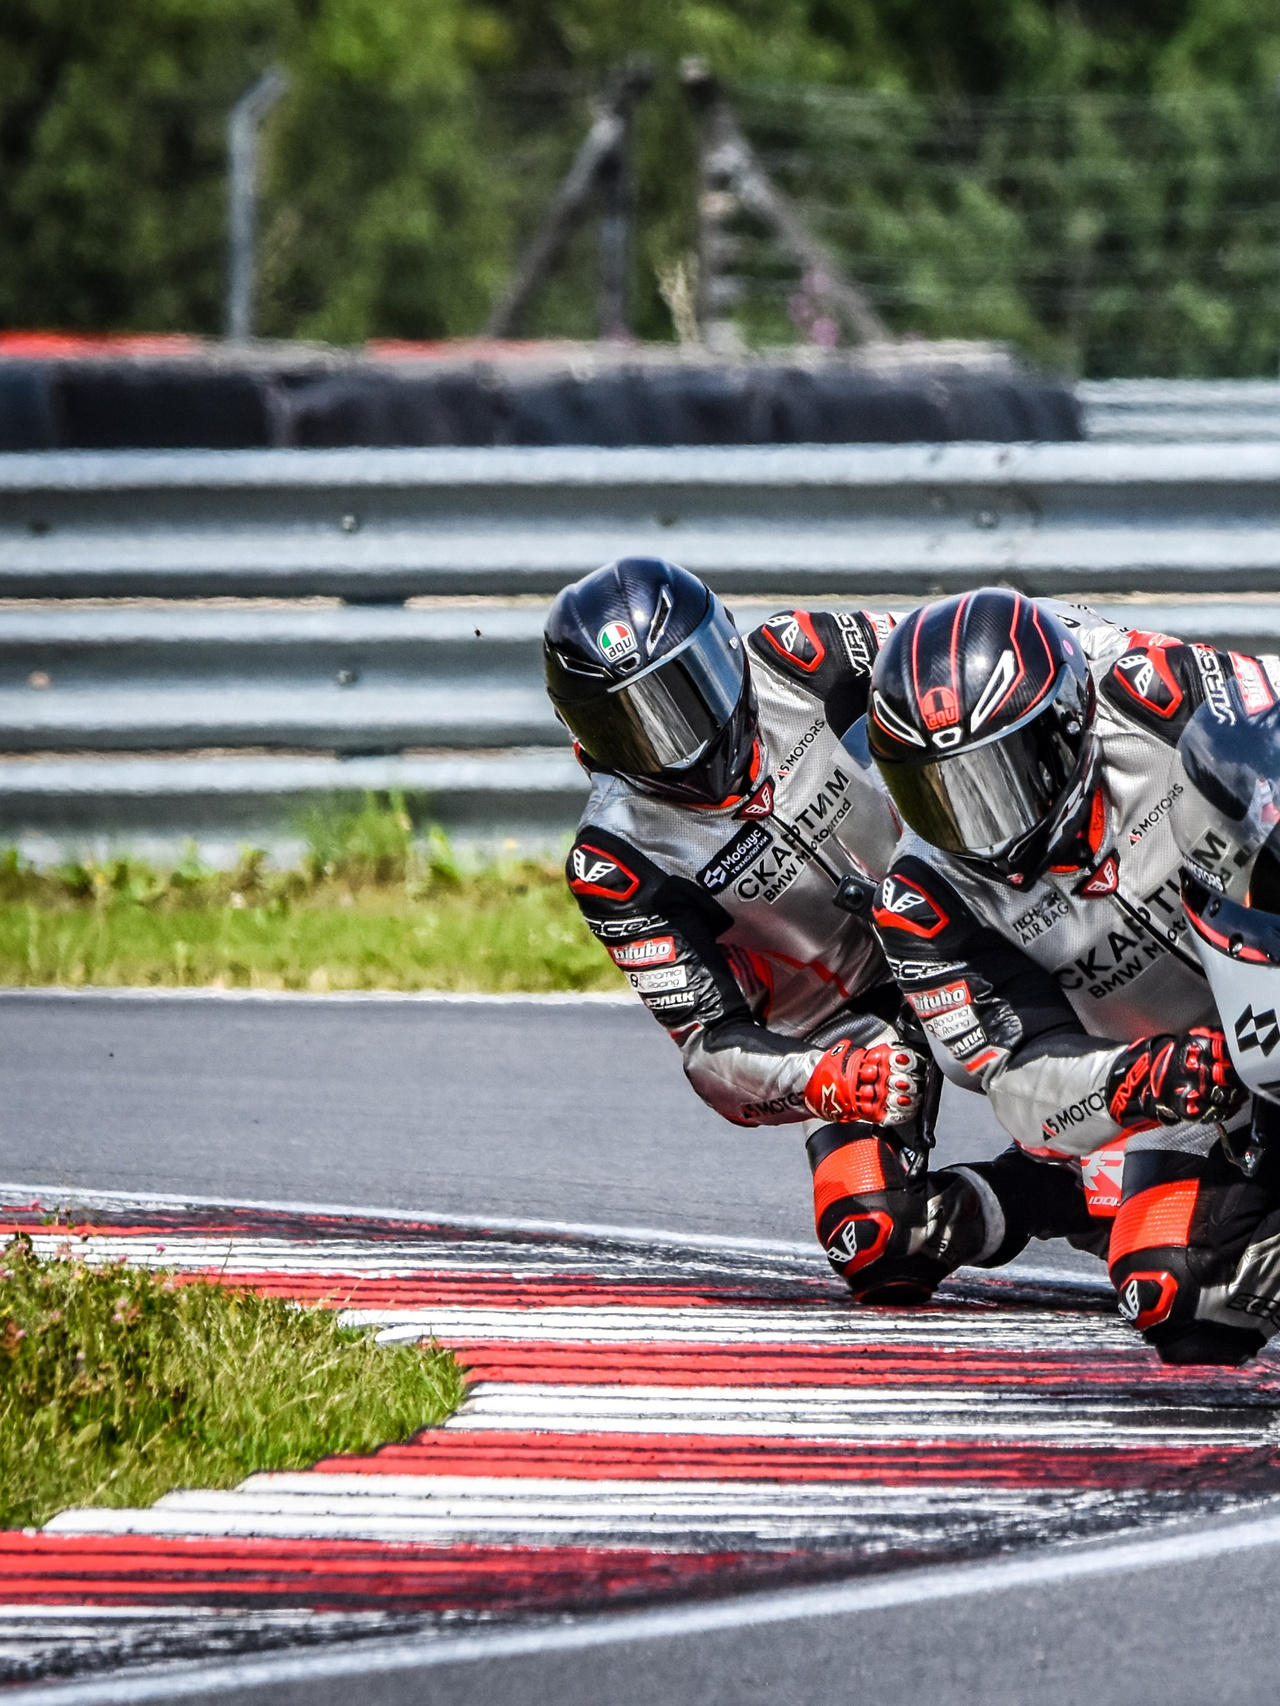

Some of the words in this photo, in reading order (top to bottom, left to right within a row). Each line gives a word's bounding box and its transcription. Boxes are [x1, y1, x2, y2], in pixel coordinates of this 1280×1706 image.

[788, 719, 826, 769] MOTORS
[1138, 782, 1184, 834] MOTORS
[721, 828, 762, 870] Мобиус
[731, 835, 769, 875] технологии
[763, 864, 798, 903] BMW
[795, 797, 852, 866] Motorrad
[1021, 919, 1045, 946] AIR
[1043, 902, 1071, 931] BAG
[612, 940, 672, 961] bitubo
[1088, 959, 1144, 999] BMW
[757, 1091, 804, 1116] MOTO
[1057, 1087, 1109, 1131] MOTO
